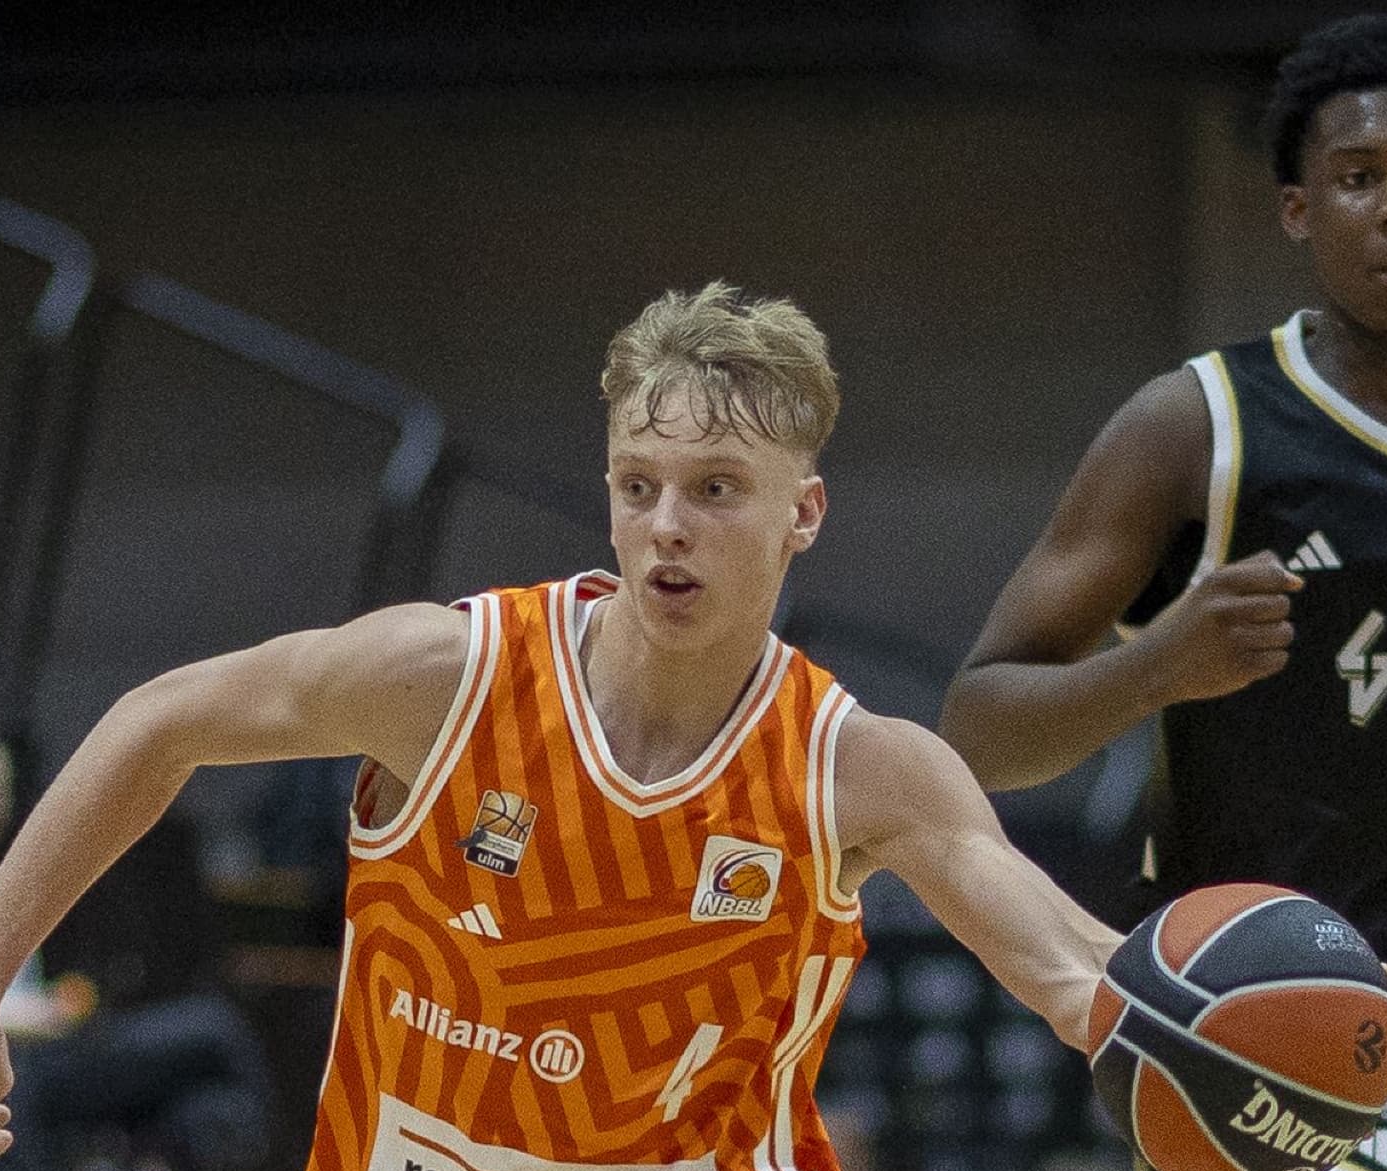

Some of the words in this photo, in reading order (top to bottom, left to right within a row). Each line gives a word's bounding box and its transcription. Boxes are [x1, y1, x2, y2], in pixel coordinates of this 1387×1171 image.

[477, 852, 506, 871] ulm
[697, 891, 762, 917] NBBL
[388, 987, 524, 1063] Allianz
[652, 1022, 725, 1124] 4
